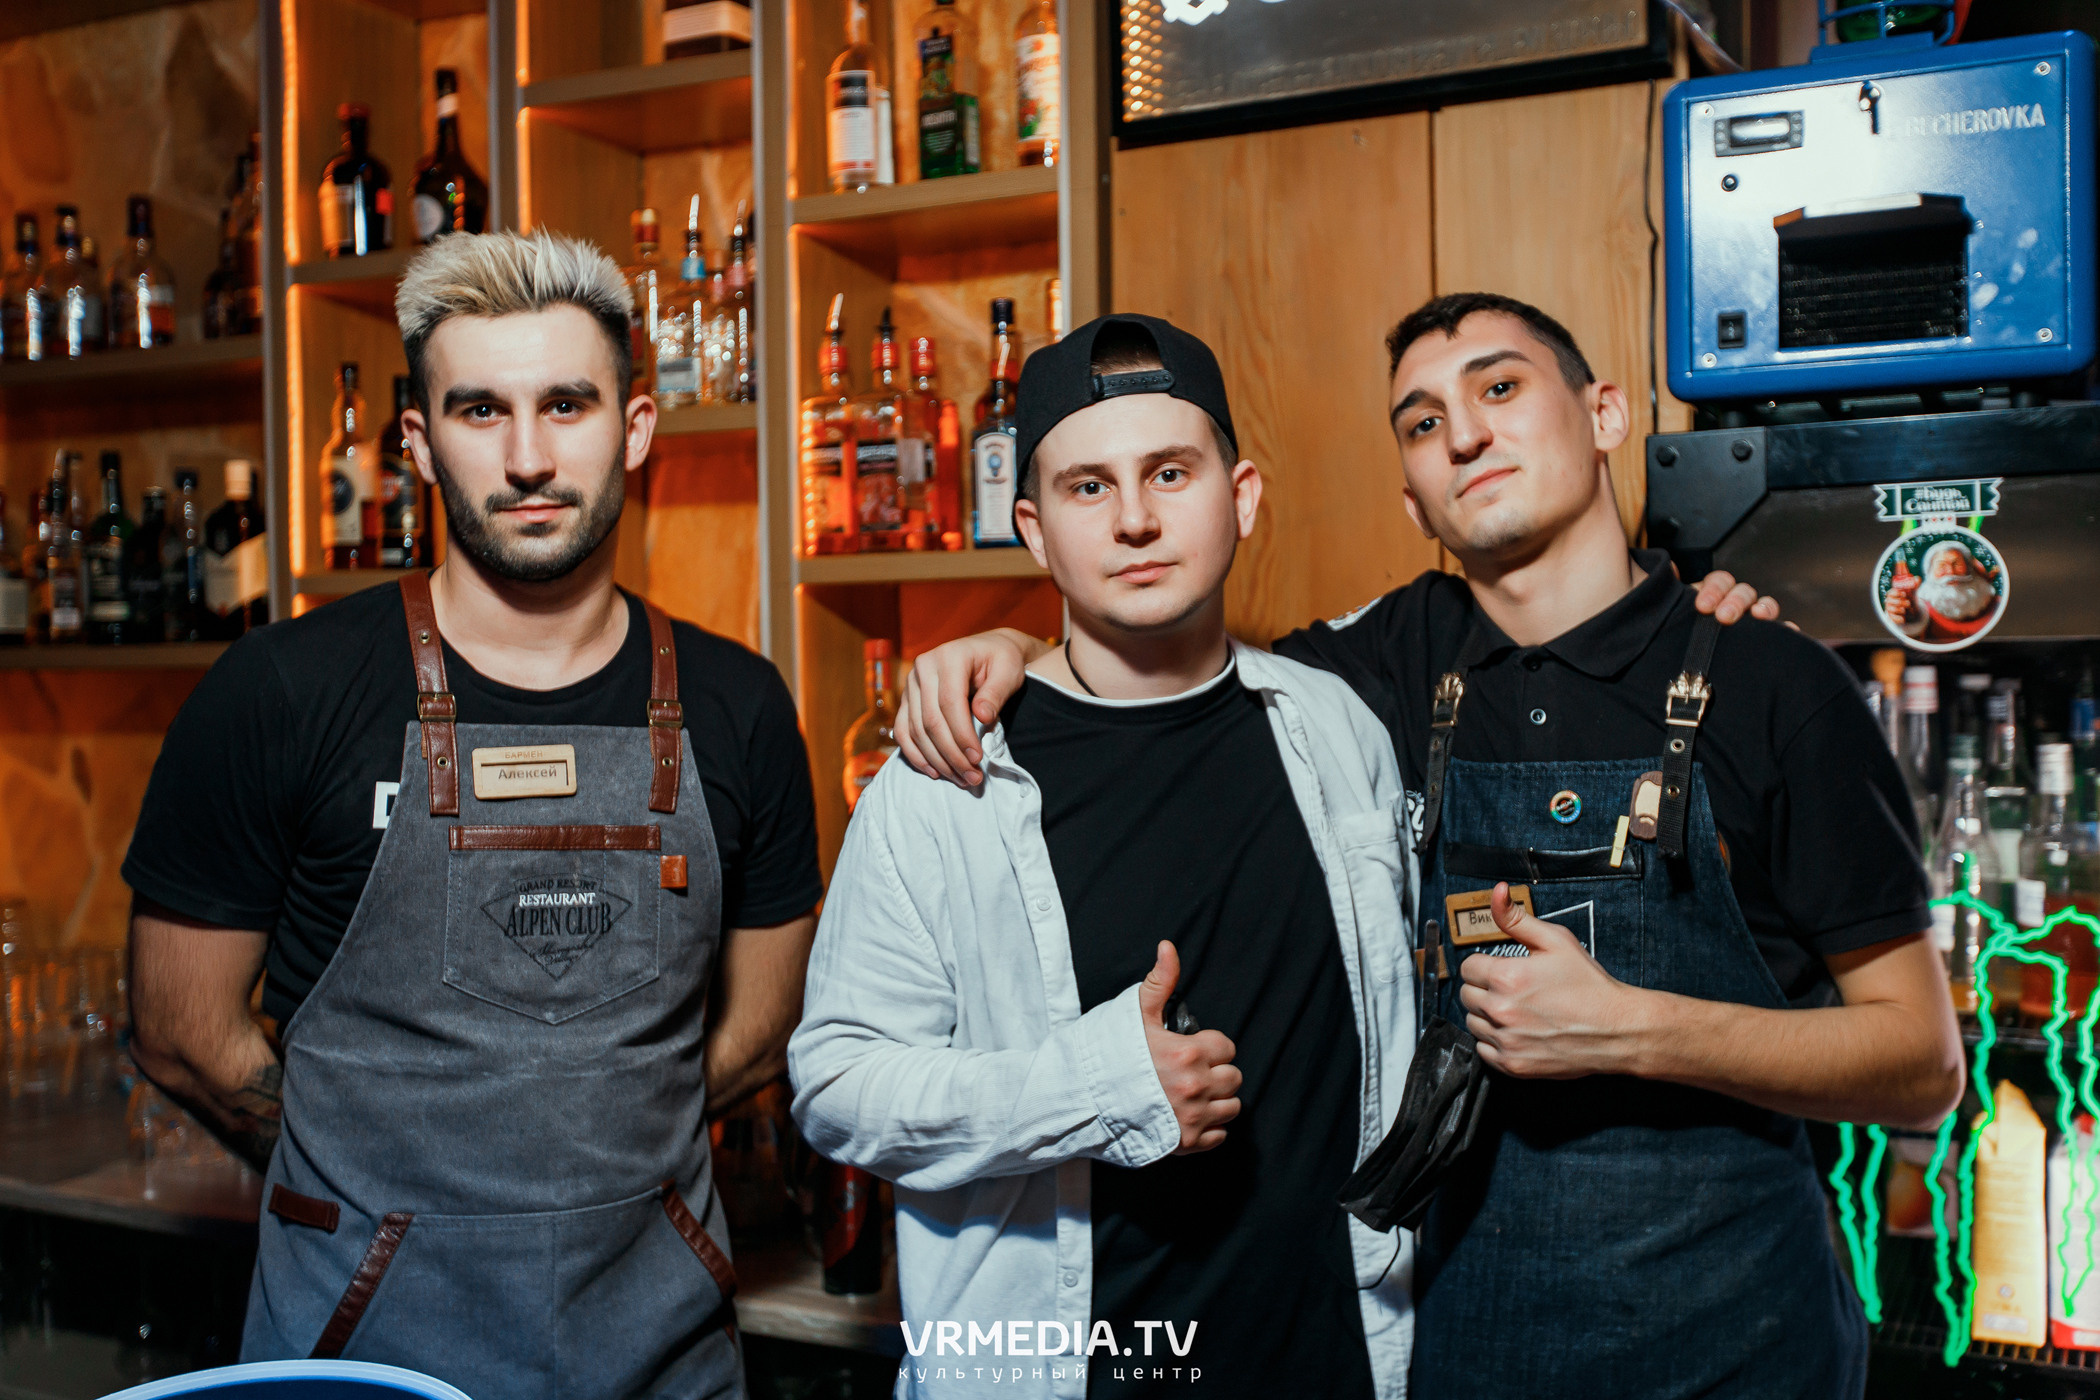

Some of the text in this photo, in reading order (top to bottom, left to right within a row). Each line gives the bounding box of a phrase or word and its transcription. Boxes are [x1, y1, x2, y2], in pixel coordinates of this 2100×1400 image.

[504, 750, 543, 759] БАРМЕН
[498, 765, 557, 779] Алексей
[518, 878, 554, 893] GRAND
[518, 892, 596, 907] RESTAURANT
[504, 901, 612, 937] ALPEN CLUB
